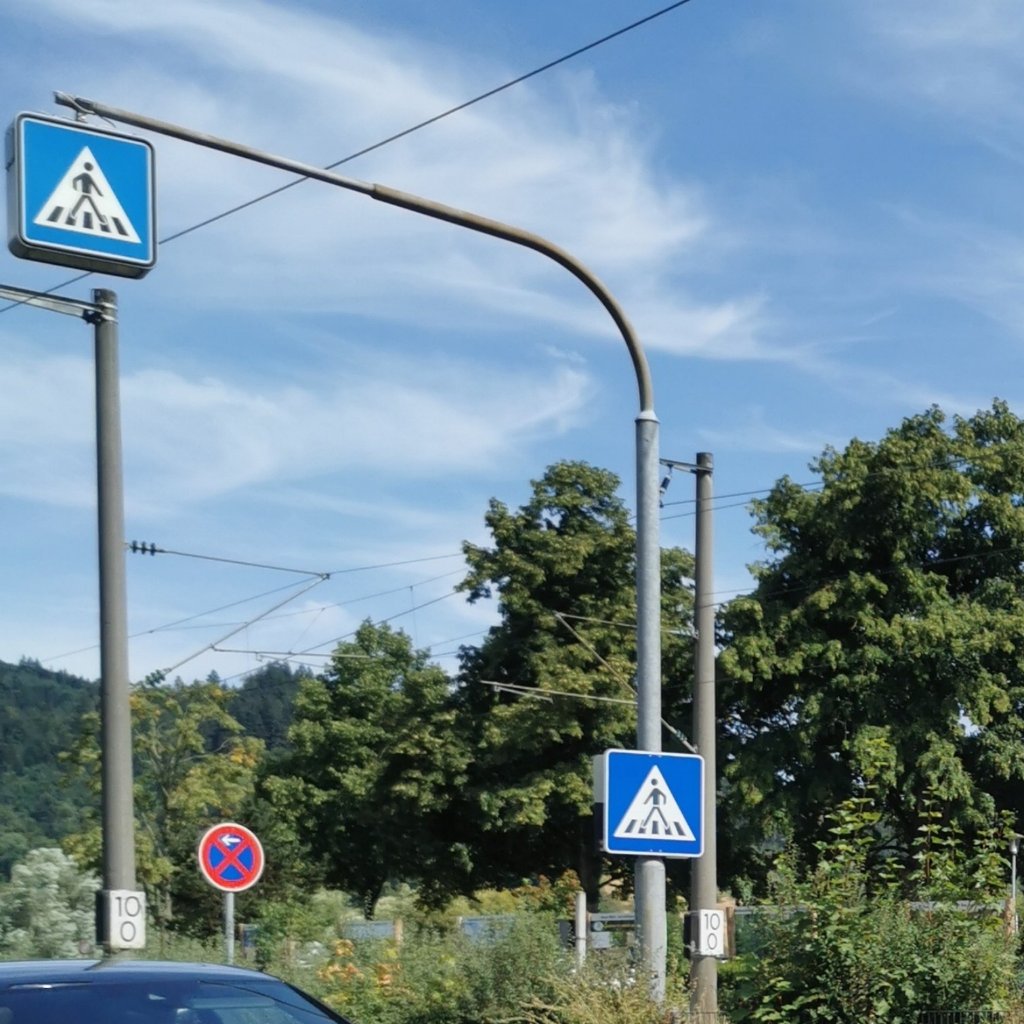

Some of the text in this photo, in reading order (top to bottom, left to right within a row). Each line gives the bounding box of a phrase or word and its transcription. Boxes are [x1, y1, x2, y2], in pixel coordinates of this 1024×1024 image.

[114, 895, 141, 917] 10
[120, 920, 137, 942] 0
[704, 912, 721, 931] 10
[707, 932, 718, 950] 0
